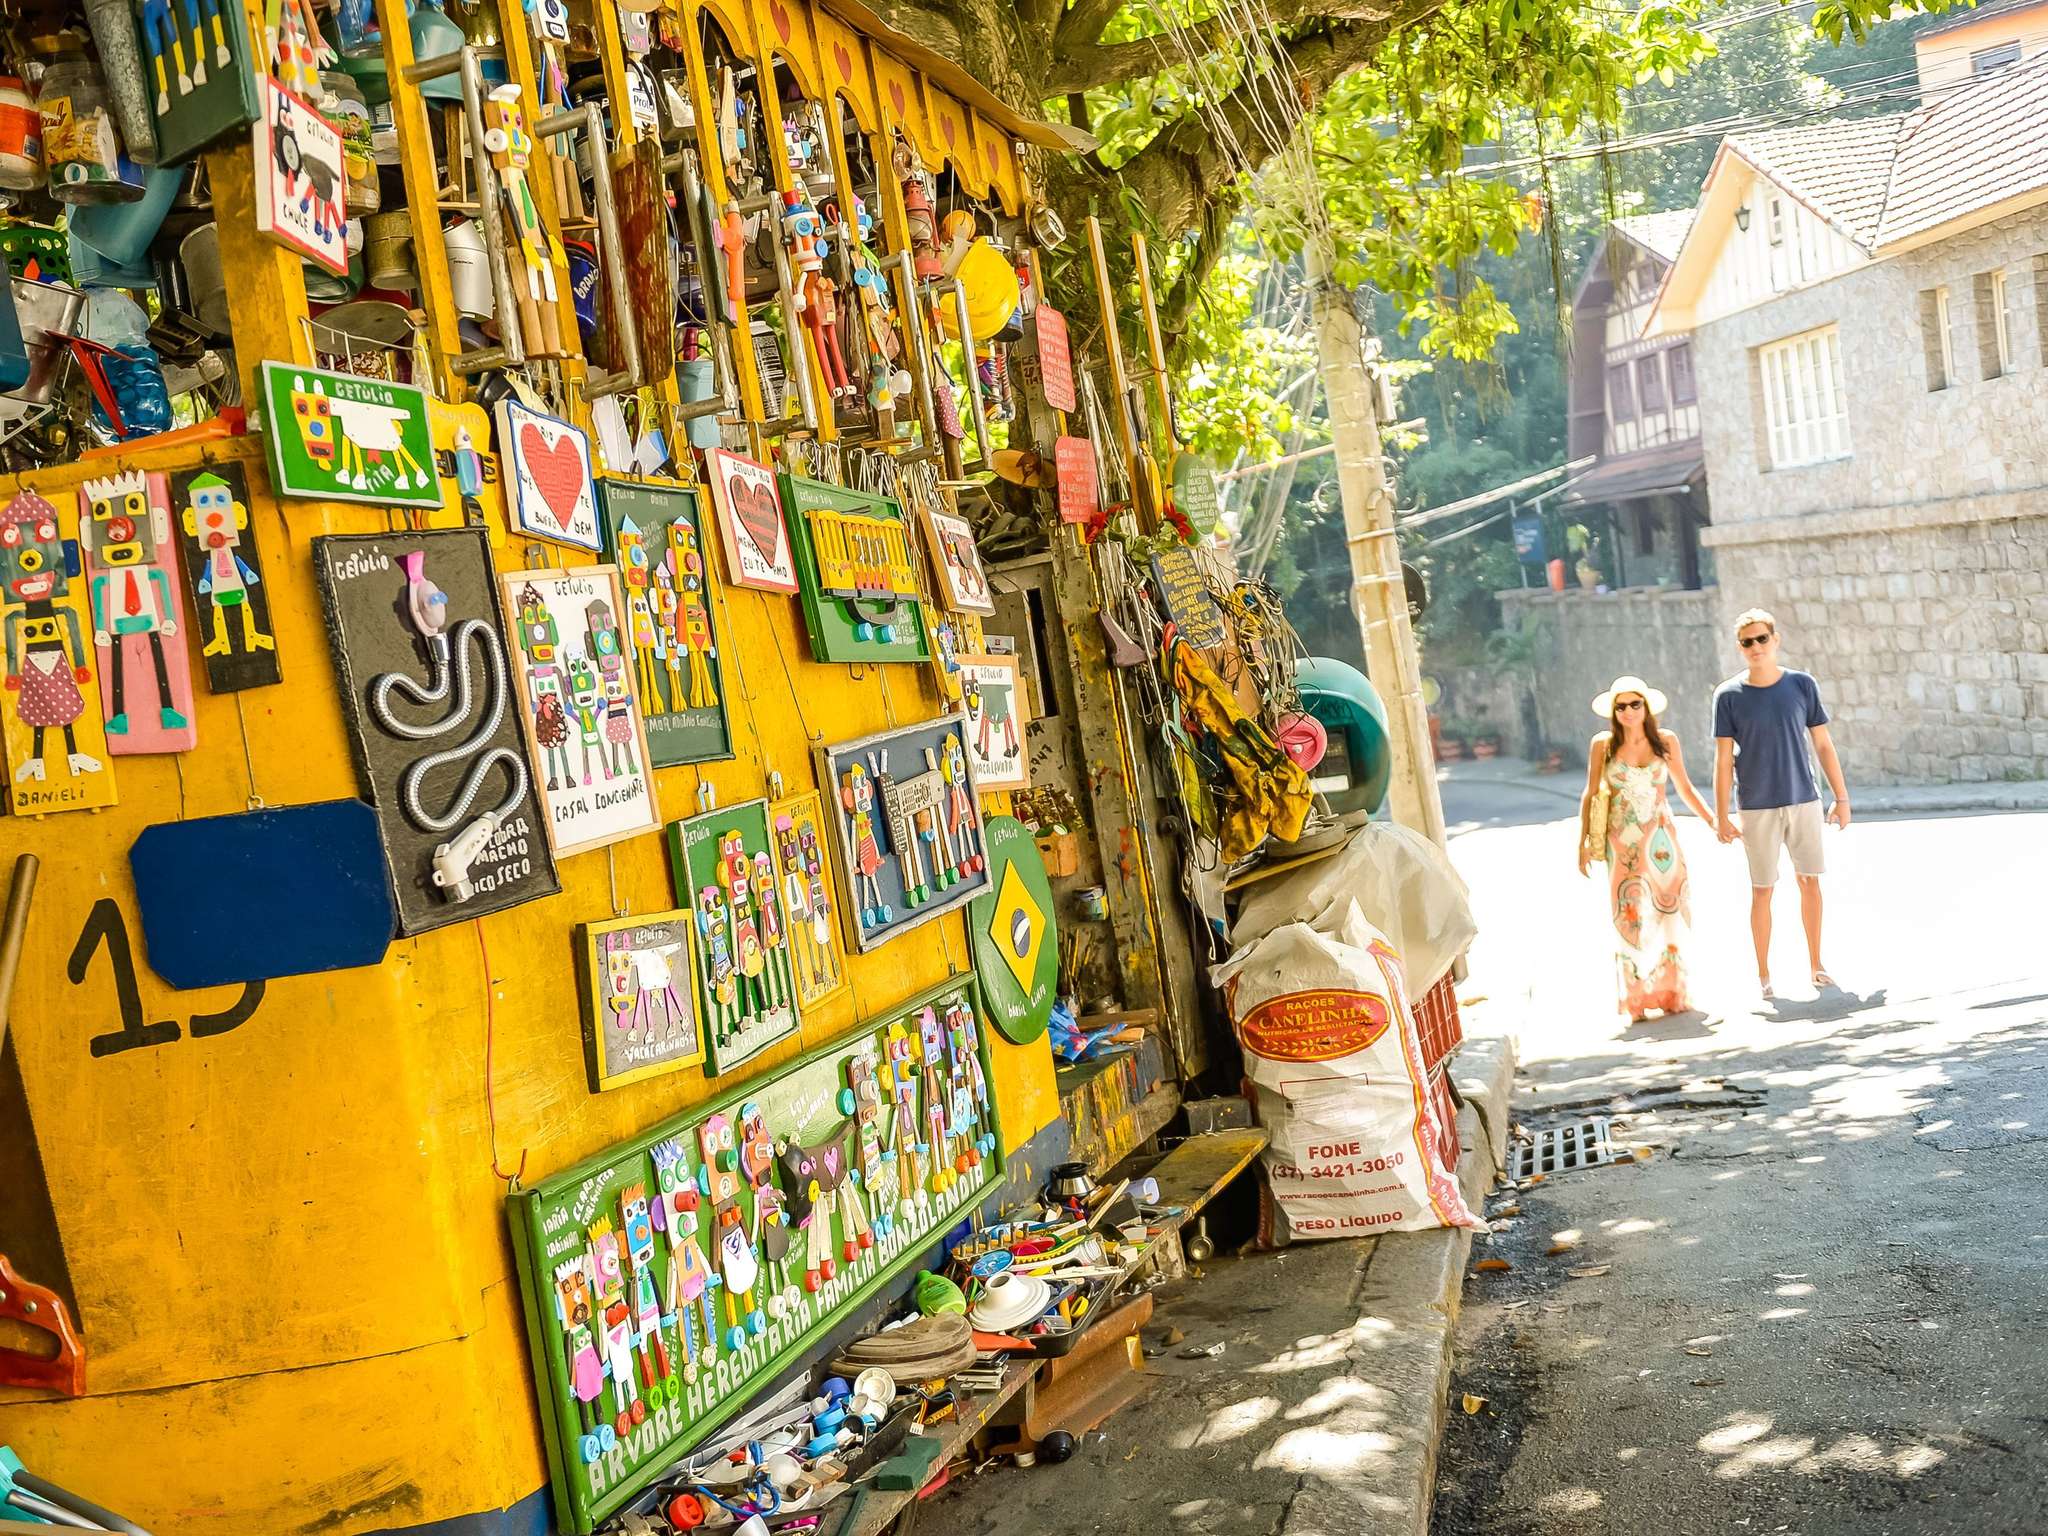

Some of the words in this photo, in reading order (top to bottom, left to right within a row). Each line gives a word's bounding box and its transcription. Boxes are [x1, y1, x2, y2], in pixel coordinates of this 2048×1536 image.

[1259, 1004, 1372, 1030] CANELINHA
[1308, 1142, 1362, 1160] FONE
[1310, 1152, 1405, 1180] 3421-3050
[1296, 1218, 1335, 1232] PESO
[1340, 1210, 1403, 1229] LÍQUIDO
